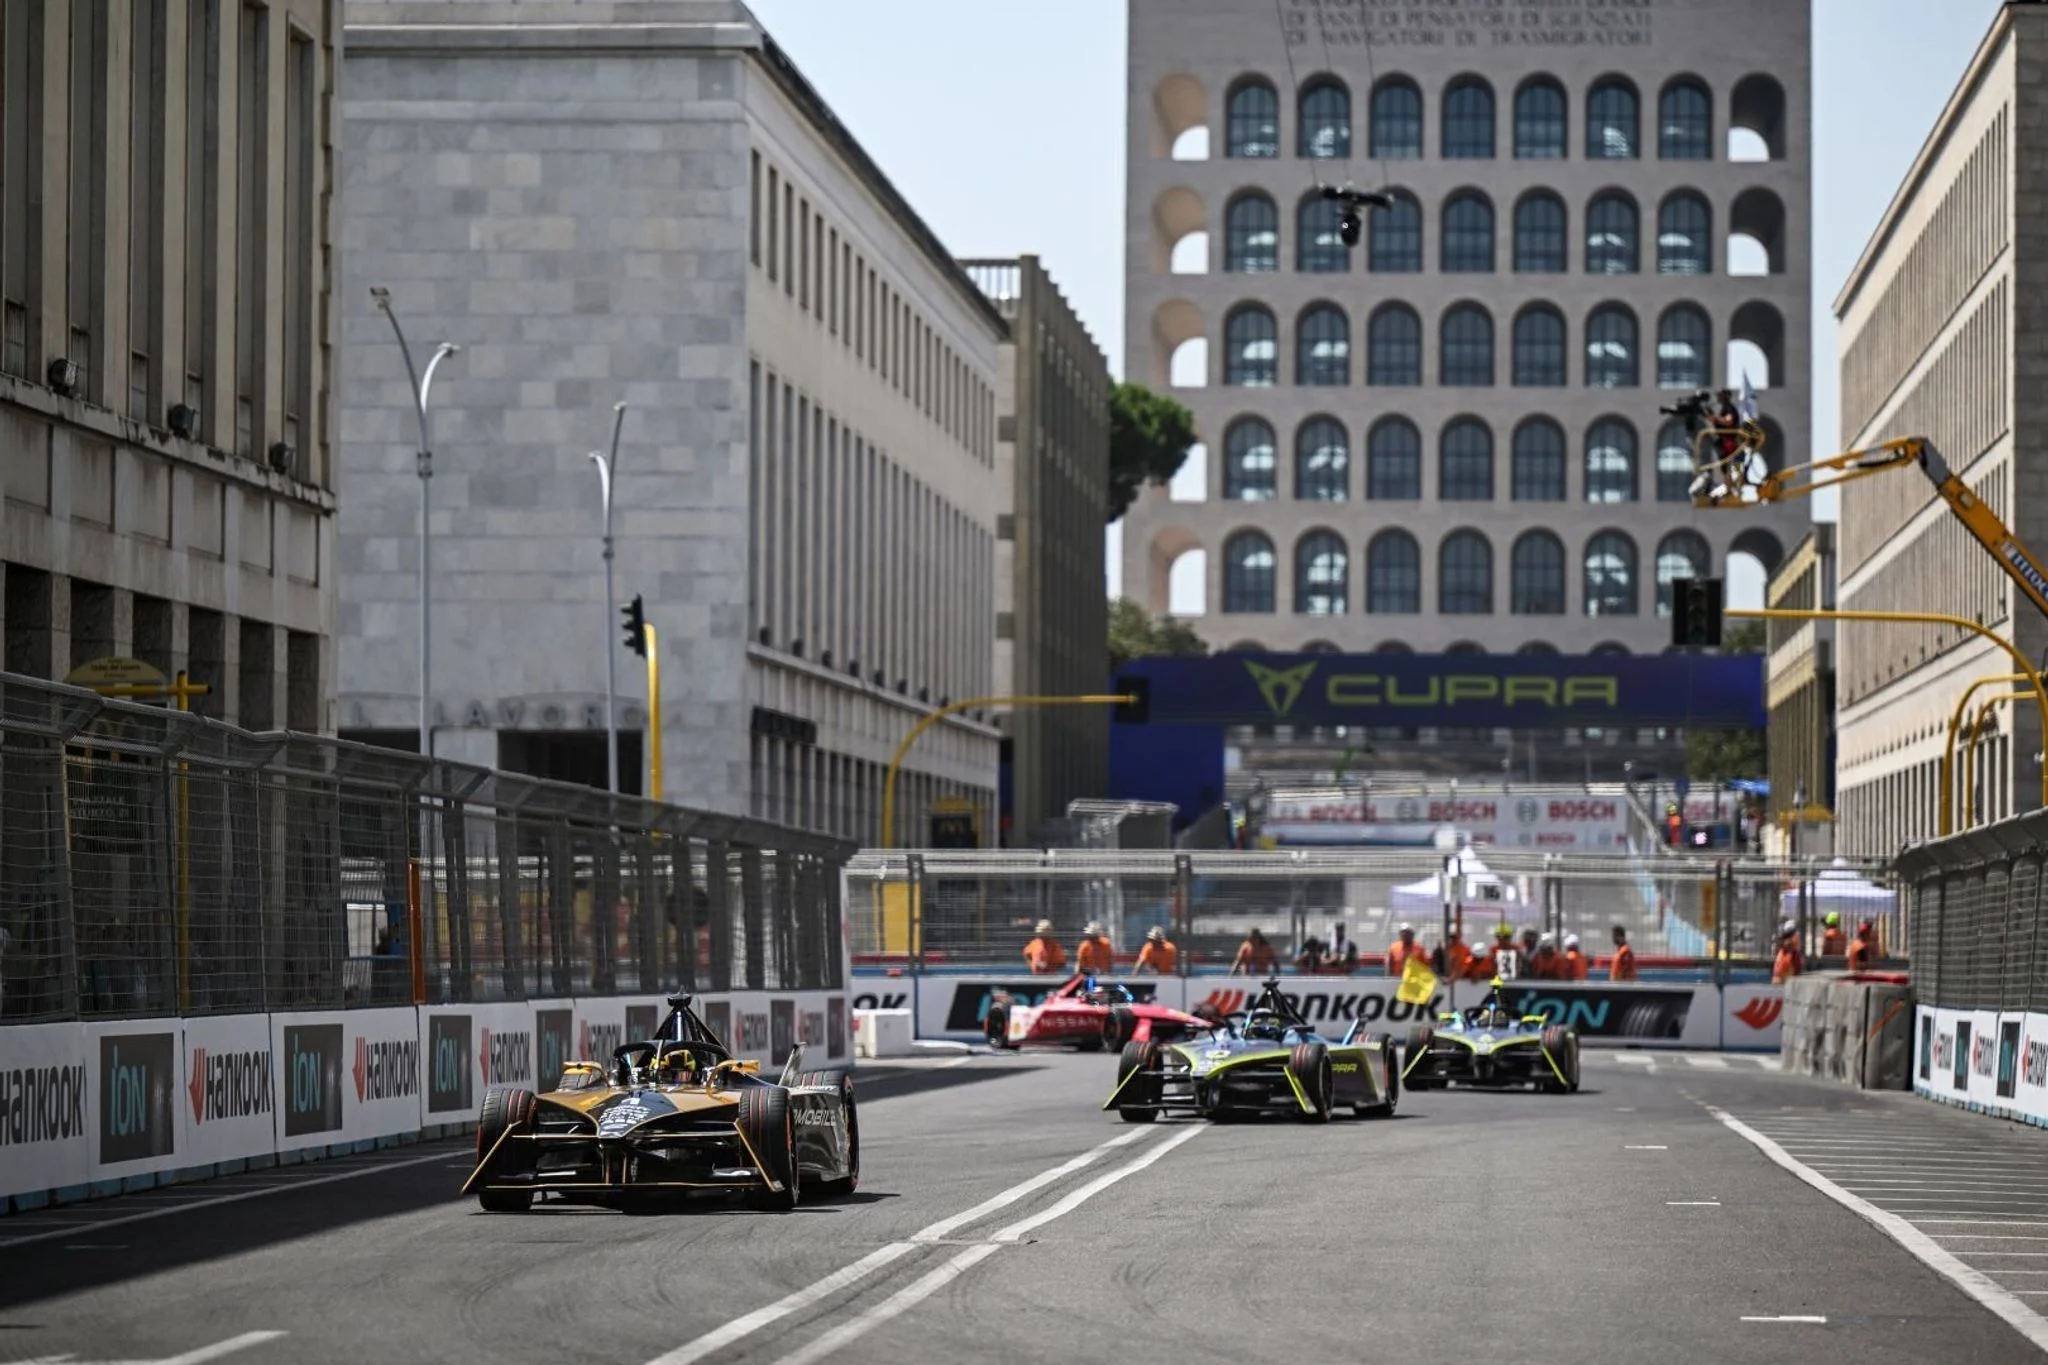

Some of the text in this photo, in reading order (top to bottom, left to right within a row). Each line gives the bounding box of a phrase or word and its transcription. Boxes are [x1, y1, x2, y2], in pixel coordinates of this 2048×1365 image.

[1327, 675, 1618, 707] CUPRA
[1429, 801, 1496, 821] BOSCH
[1548, 800, 1616, 820] BOSCH
[1041, 1017, 1099, 1028] NISSAN
[793, 1108, 838, 1128] MOBILE
